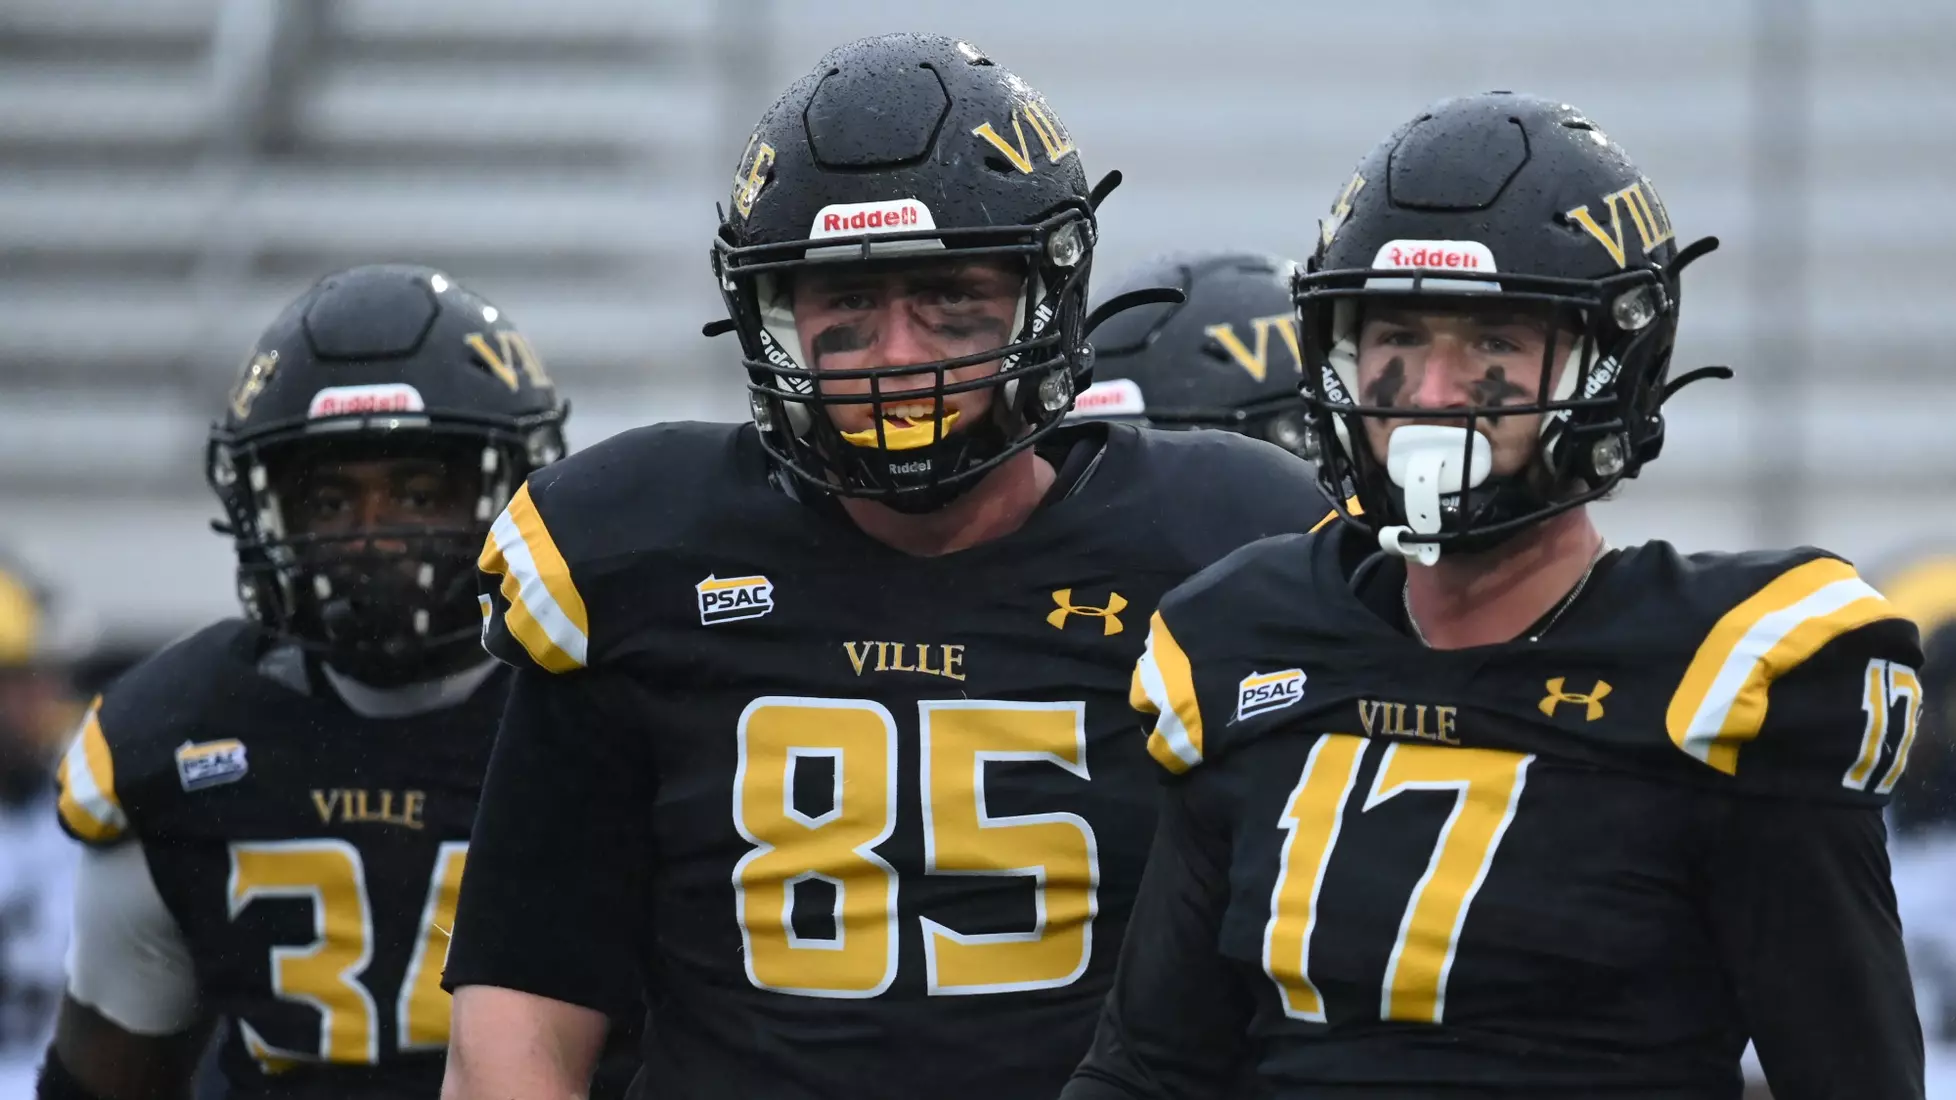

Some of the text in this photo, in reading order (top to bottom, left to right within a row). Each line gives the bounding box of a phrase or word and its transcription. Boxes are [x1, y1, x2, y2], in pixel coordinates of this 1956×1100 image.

[824, 206, 918, 232] Riddell
[1389, 248, 1478, 268] Riddell
[1000, 304, 1053, 373] Riell
[702, 586, 768, 612] PSAC
[843, 641, 966, 681] VILLE
[1242, 678, 1300, 706] PSAC
[1358, 699, 1461, 745] VILLE
[1841, 657, 1924, 795] 17
[311, 789, 426, 830] VILLE
[733, 695, 1099, 998] 85
[1262, 733, 1537, 1024] 17
